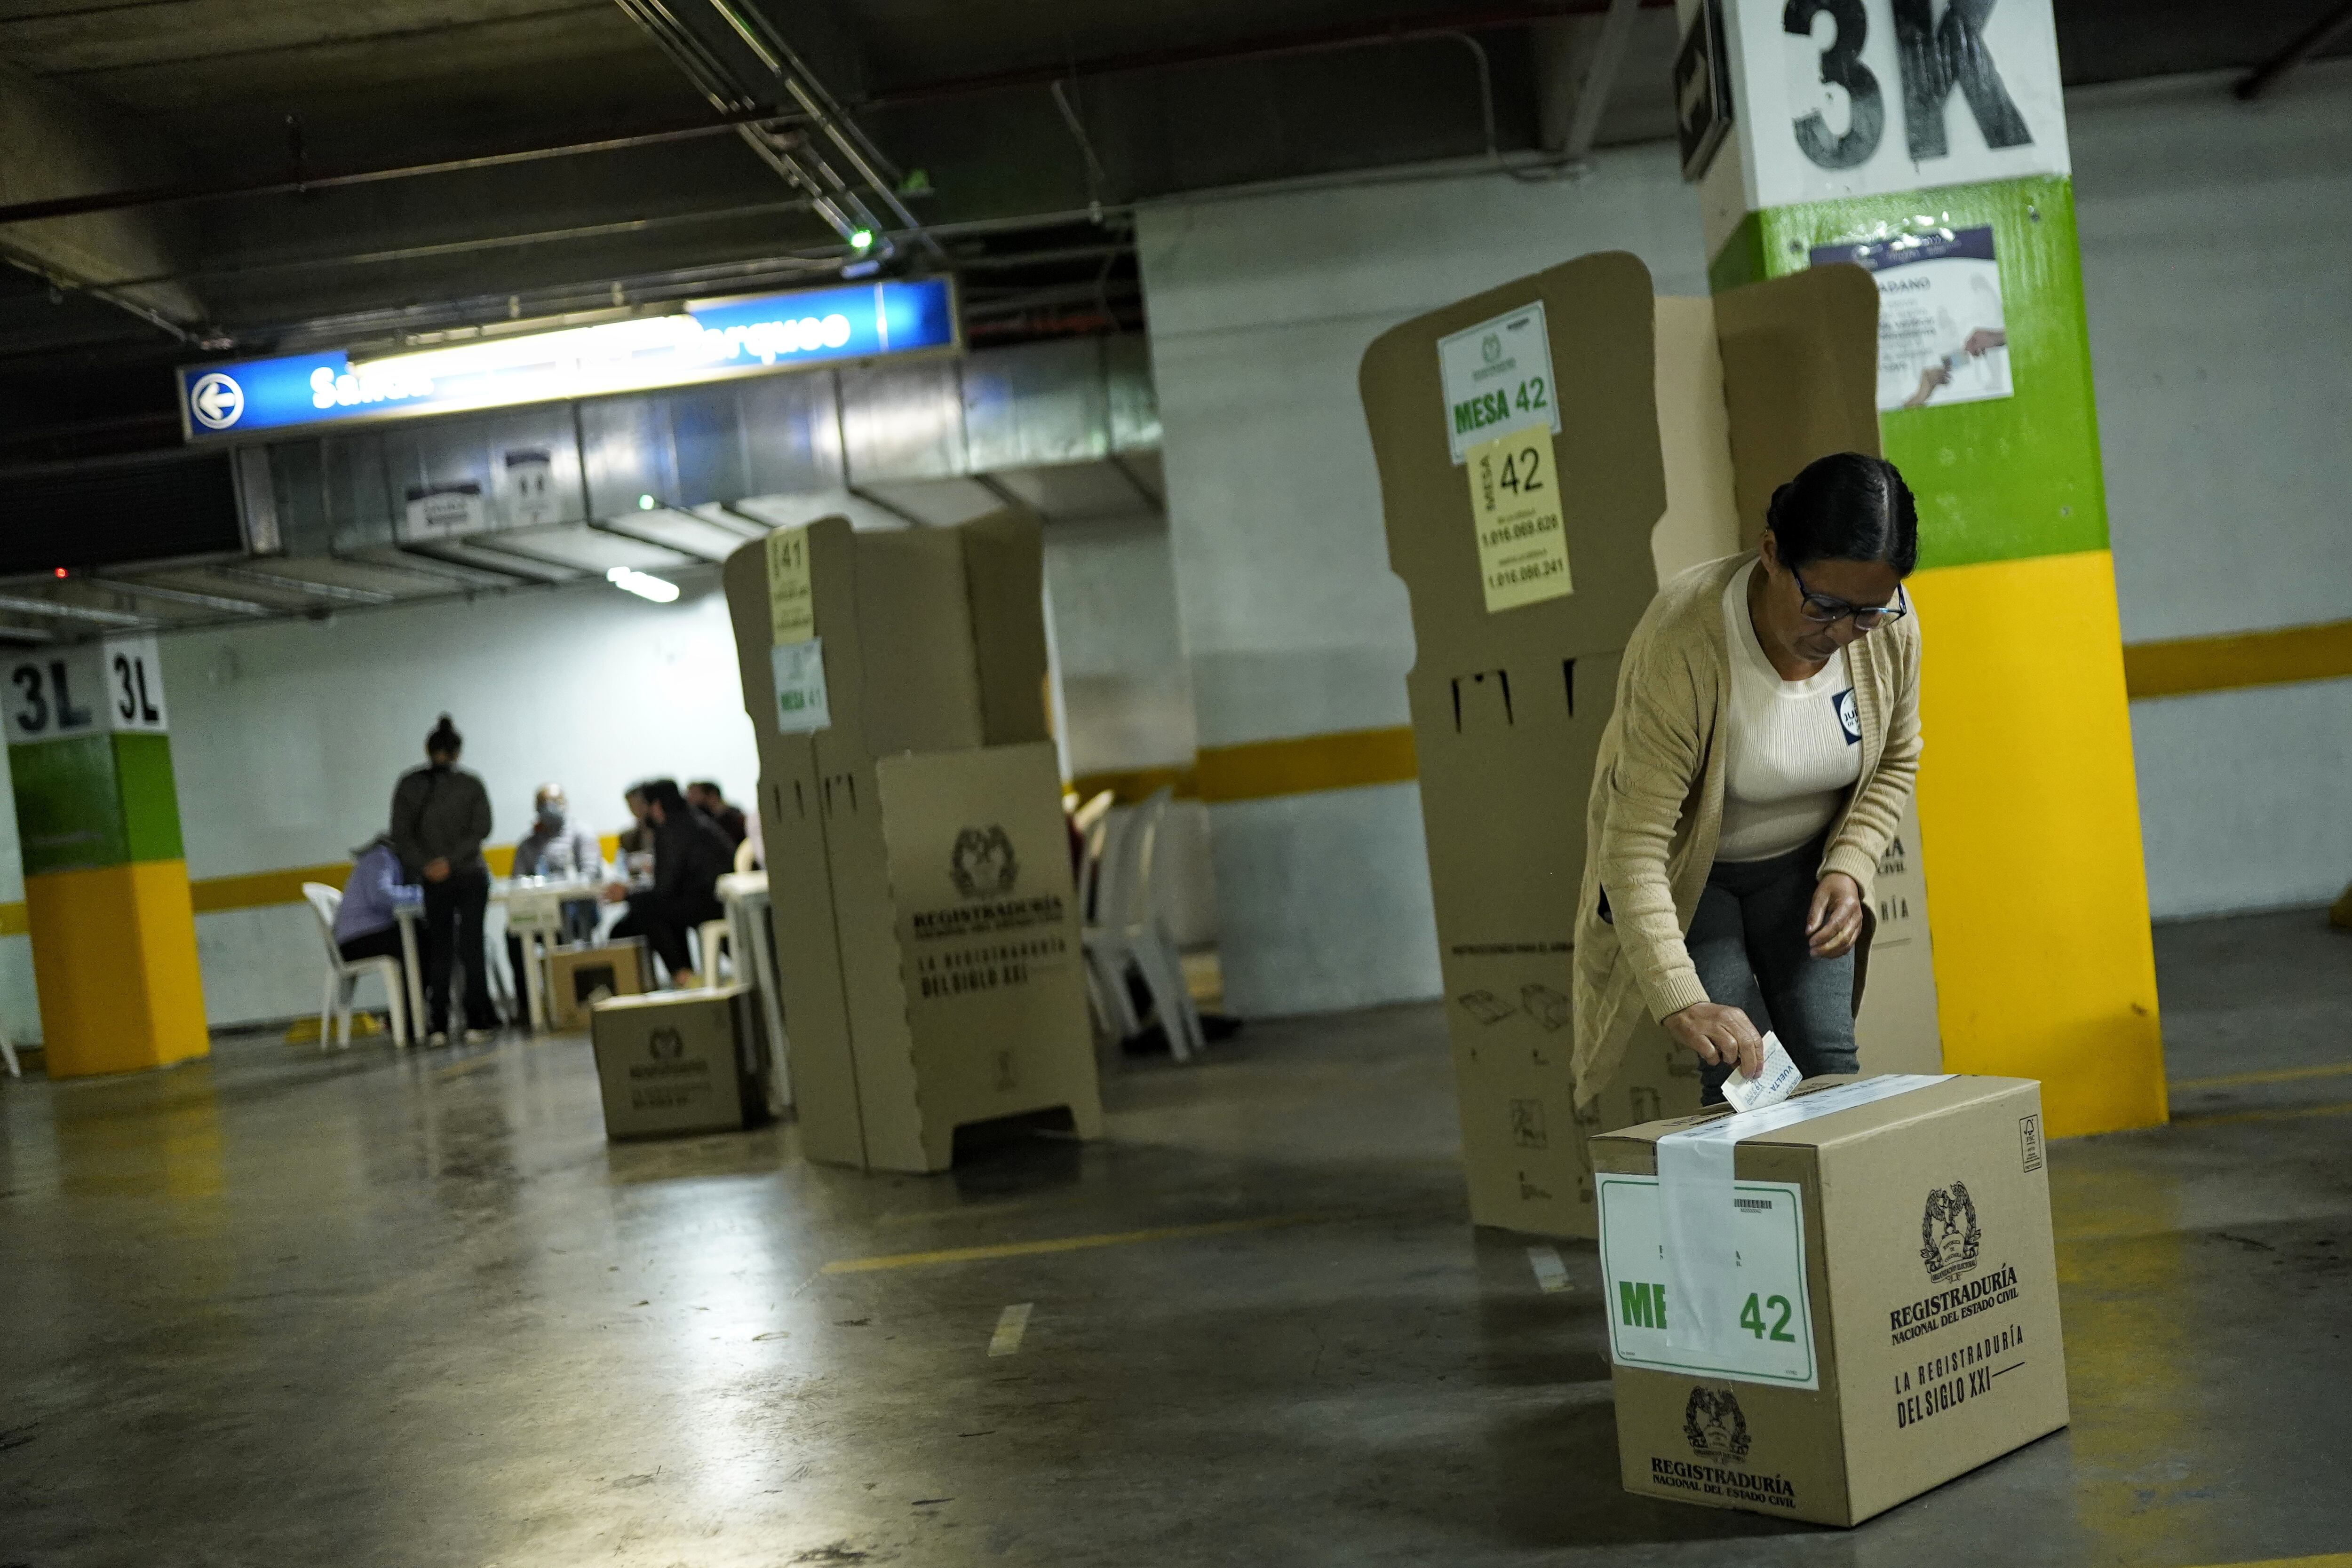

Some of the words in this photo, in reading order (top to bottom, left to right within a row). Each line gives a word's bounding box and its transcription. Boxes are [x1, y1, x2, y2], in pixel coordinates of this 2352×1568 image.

[1783, 0, 2035, 171] 3K
[1453, 388, 1509, 434] MESA
[1515, 377, 1548, 412] 42
[1501, 446, 1544, 495] 42
[12, 658, 92, 732] 3L
[114, 653, 159, 722] 3L
[1755, 1080, 1763, 1091] 19
[1770, 1065, 1794, 1092] VUELTA
[1619, 1281, 1667, 1329] ME
[1740, 1292, 1796, 1343] 42
[1890, 1263, 2017, 1331] REGISTRADURÍA
[1892, 1321, 1939, 1346] NACIONAL
[1941, 1311, 1959, 1327] DEL
[1961, 1297, 1995, 1320] ESTADO
[1997, 1288, 2019, 1305] CIVIL
[1895, 1372, 1911, 1395] LA
[1919, 1324, 2023, 1386] REGISTRADURÍA
[1898, 1395, 1924, 1429] DEL
[1926, 1377, 1965, 1417] SIGLO
[1970, 1366, 1991, 1398] XXI
[1651, 1457, 1795, 1497] REGISTRADURÍA
[1653, 1474, 1701, 1490] NACIONAL
[1704, 1484, 1723, 1496] DEL
[1727, 1489, 1766, 1503] ESTADO
[1768, 1496, 1796, 1508] CIVIL
